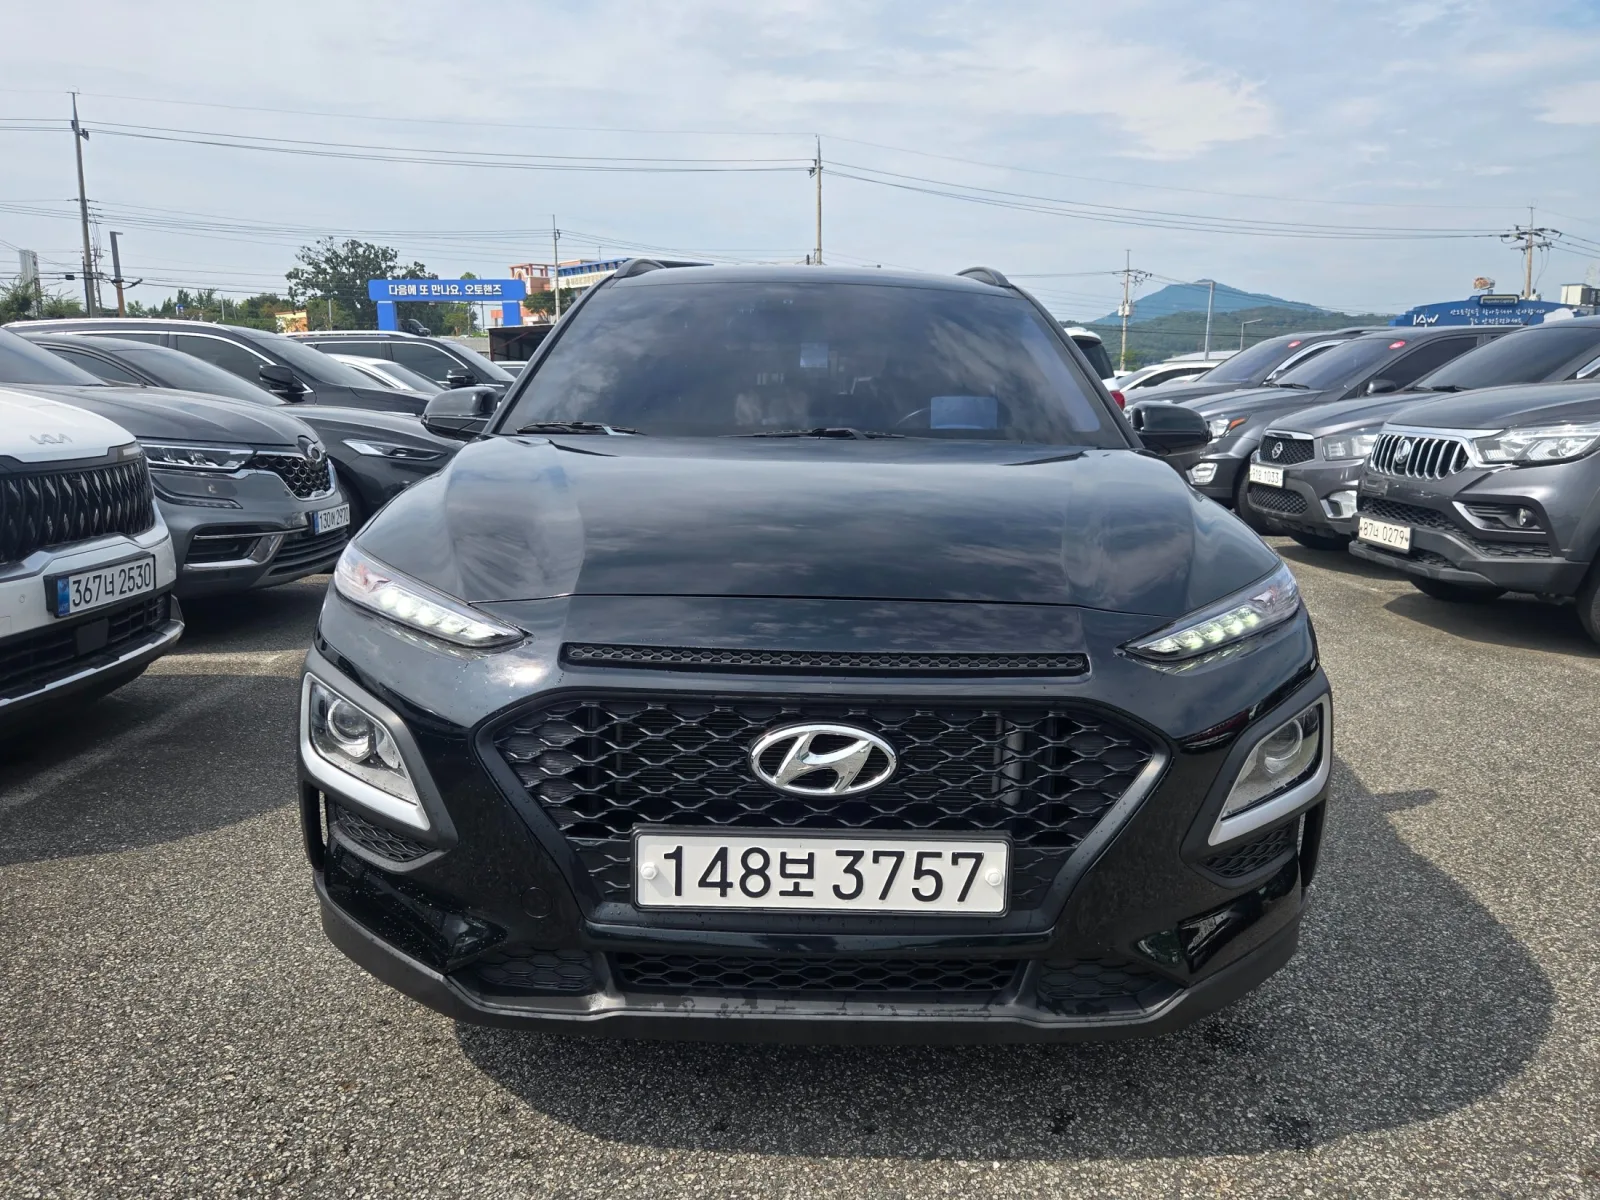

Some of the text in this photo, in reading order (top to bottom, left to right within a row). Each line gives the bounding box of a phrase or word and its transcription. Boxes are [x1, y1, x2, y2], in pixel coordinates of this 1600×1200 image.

[388, 284, 417, 295] 다음에
[419, 284, 429, 295] 또
[431, 284, 462, 296] 만나요,
[1382, 526, 1405, 545] 0279
[72, 562, 151, 607] 367너 2530
[663, 845, 985, 903] 148보 3757
